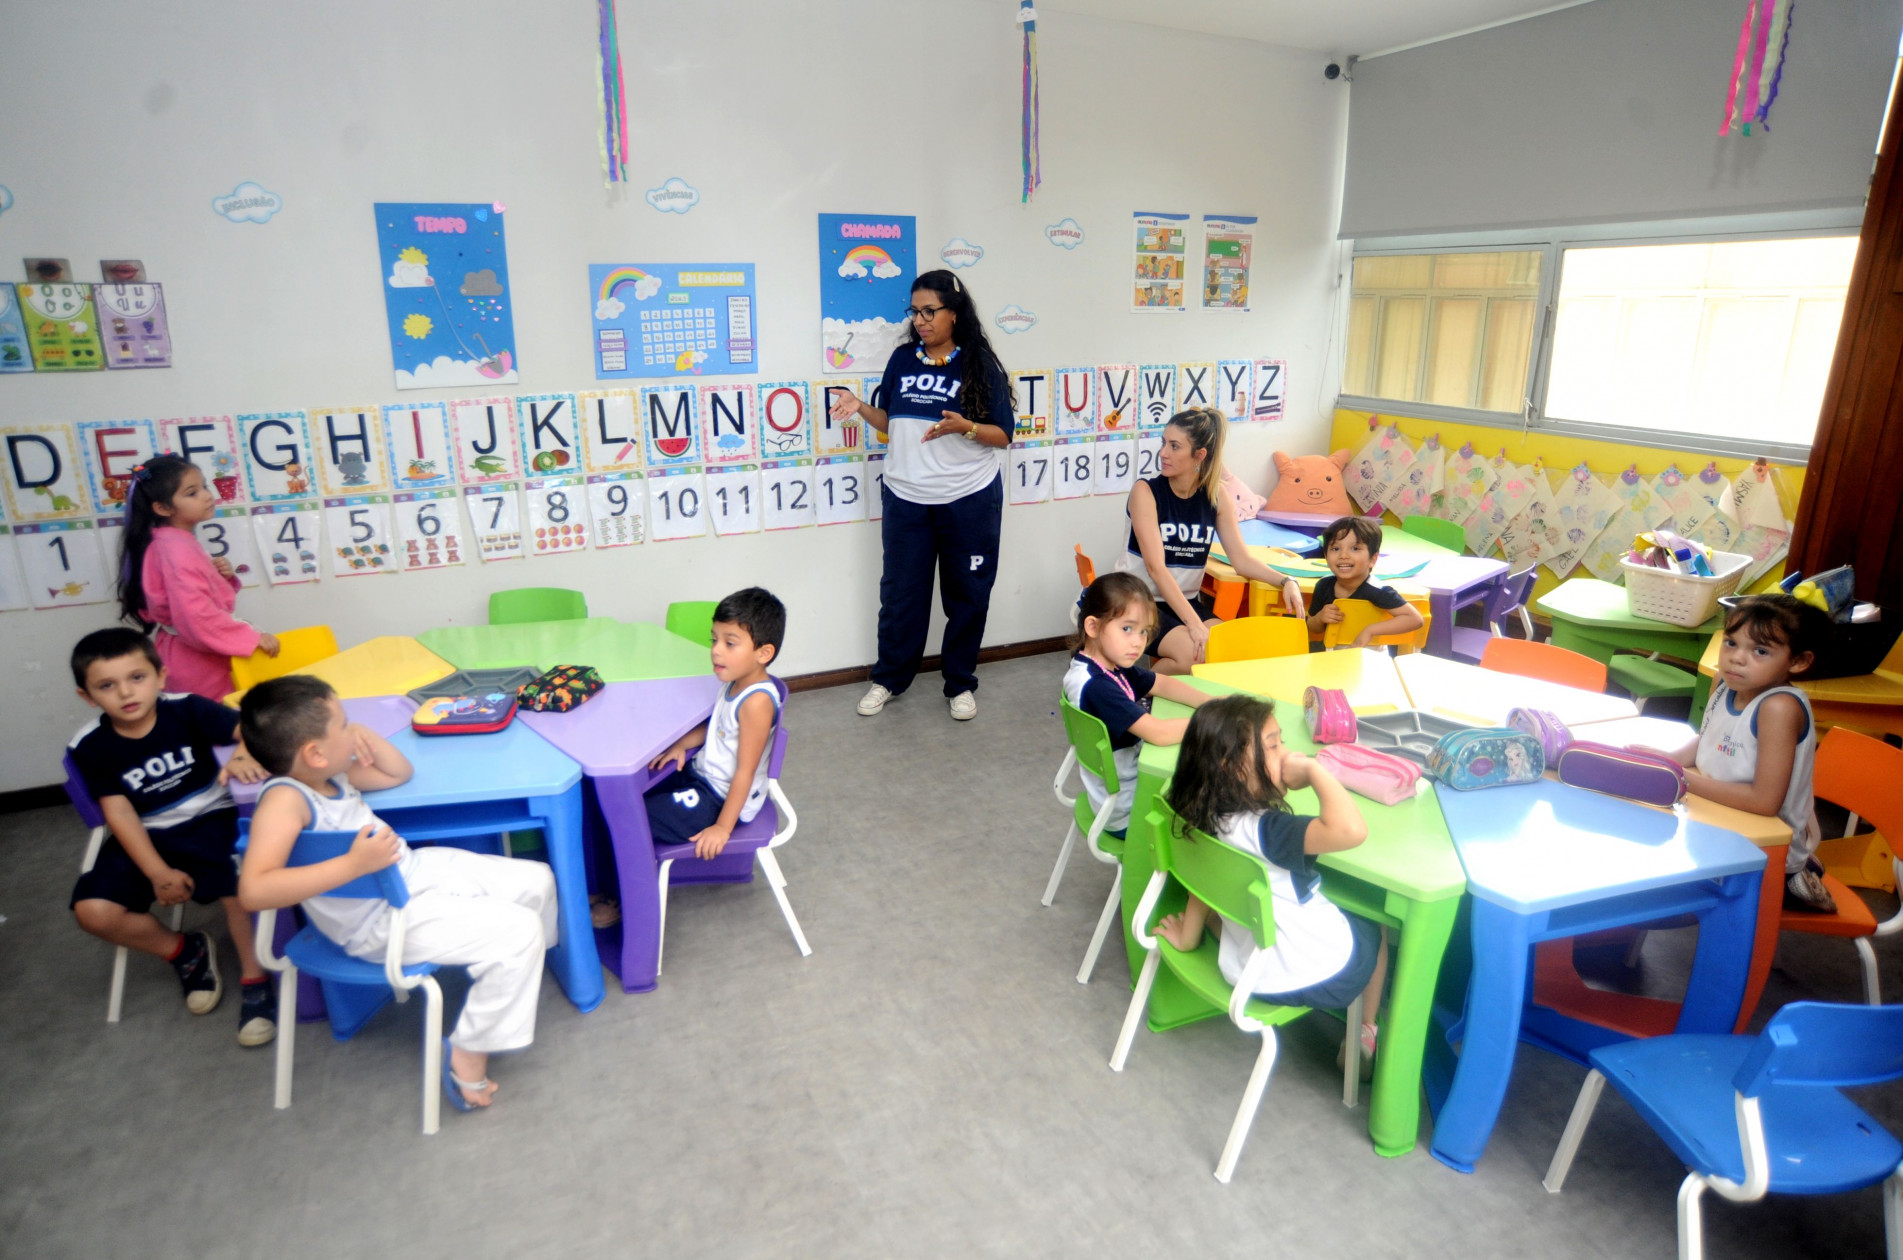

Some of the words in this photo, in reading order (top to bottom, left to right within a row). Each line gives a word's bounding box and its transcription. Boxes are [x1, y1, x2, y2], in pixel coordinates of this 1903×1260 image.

[414, 216, 467, 234] TEMPO
[841, 223, 901, 239] CHAMADA
[679, 271, 745, 285] CALENDÁRIO
[900, 374, 961, 398] POLI
[1019, 375, 1045, 415] T
[1064, 373, 1088, 412] U
[1103, 370, 1130, 408] V
[1144, 372, 1171, 399] W
[1183, 367, 1208, 404] X
[1223, 365, 1247, 401] Y
[1259, 365, 1281, 401] Z
[530, 401, 571, 449] K
[597, 398, 628, 444] L
[649, 391, 692, 439] M
[710, 391, 745, 436] N
[765, 387, 803, 432] O
[178, 424, 215, 463] F
[250, 419, 300, 471] G
[326, 413, 371, 465] H
[412, 410, 424, 459] I
[472, 406, 497, 454] J
[6, 434, 61, 489] D
[94, 427, 139, 480] E
[1060, 455, 1090, 482] 18
[1102, 451, 1130, 479] 19
[1017, 459, 1048, 487] 17
[546, 491, 569, 523] 8
[607, 485, 628, 516] 9
[657, 487, 698, 520] 10
[715, 485, 750, 516] 11
[770, 480, 808, 511] 12
[823, 475, 859, 506] 13
[349, 509, 375, 543] 5
[417, 503, 441, 536] 6
[482, 496, 505, 529] 7
[1680, 516, 1698, 535] ALICE
[202, 523, 230, 558] 3
[277, 516, 305, 550] 4
[1160, 523, 1214, 545] POLI
[49, 536, 71, 571] 1
[970, 555, 984, 570] P
[123, 746, 195, 790] POLI
[673, 788, 700, 808] P
